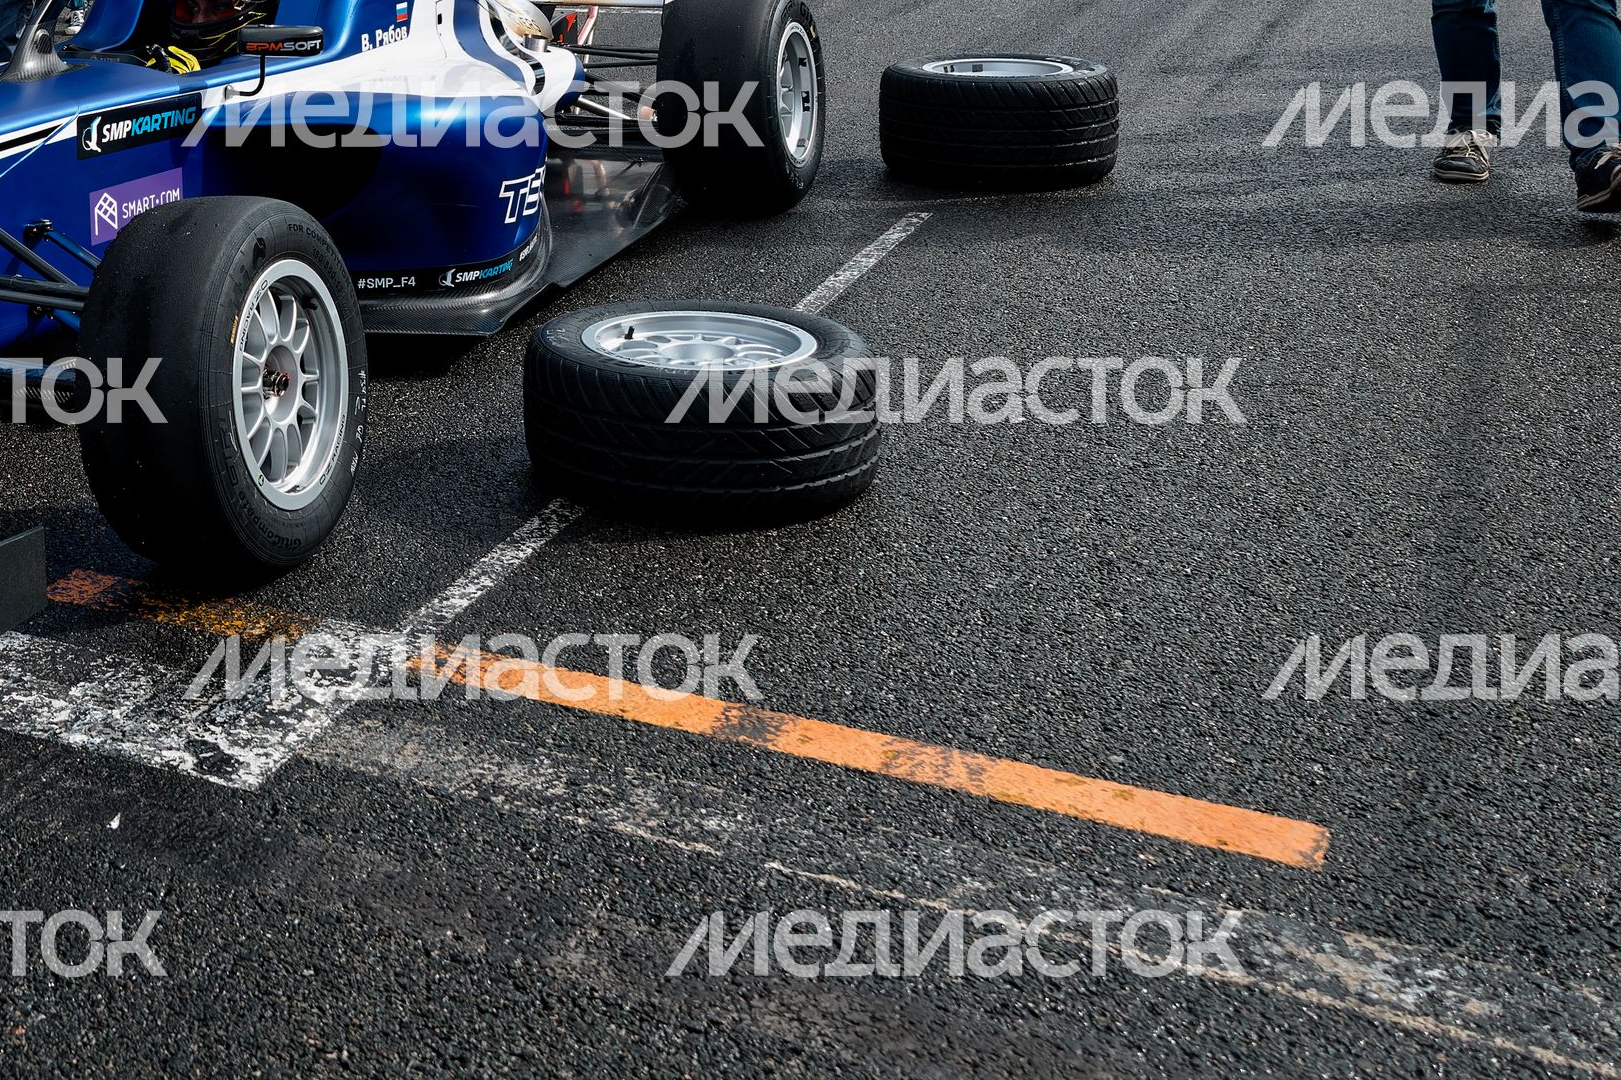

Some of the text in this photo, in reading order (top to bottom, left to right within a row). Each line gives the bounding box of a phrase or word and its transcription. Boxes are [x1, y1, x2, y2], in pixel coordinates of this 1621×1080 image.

[361, 25, 409, 50] В. Рябов
[245, 39, 322, 52] BPMSOFT
[357, 276, 416, 289] #SMP_F4
